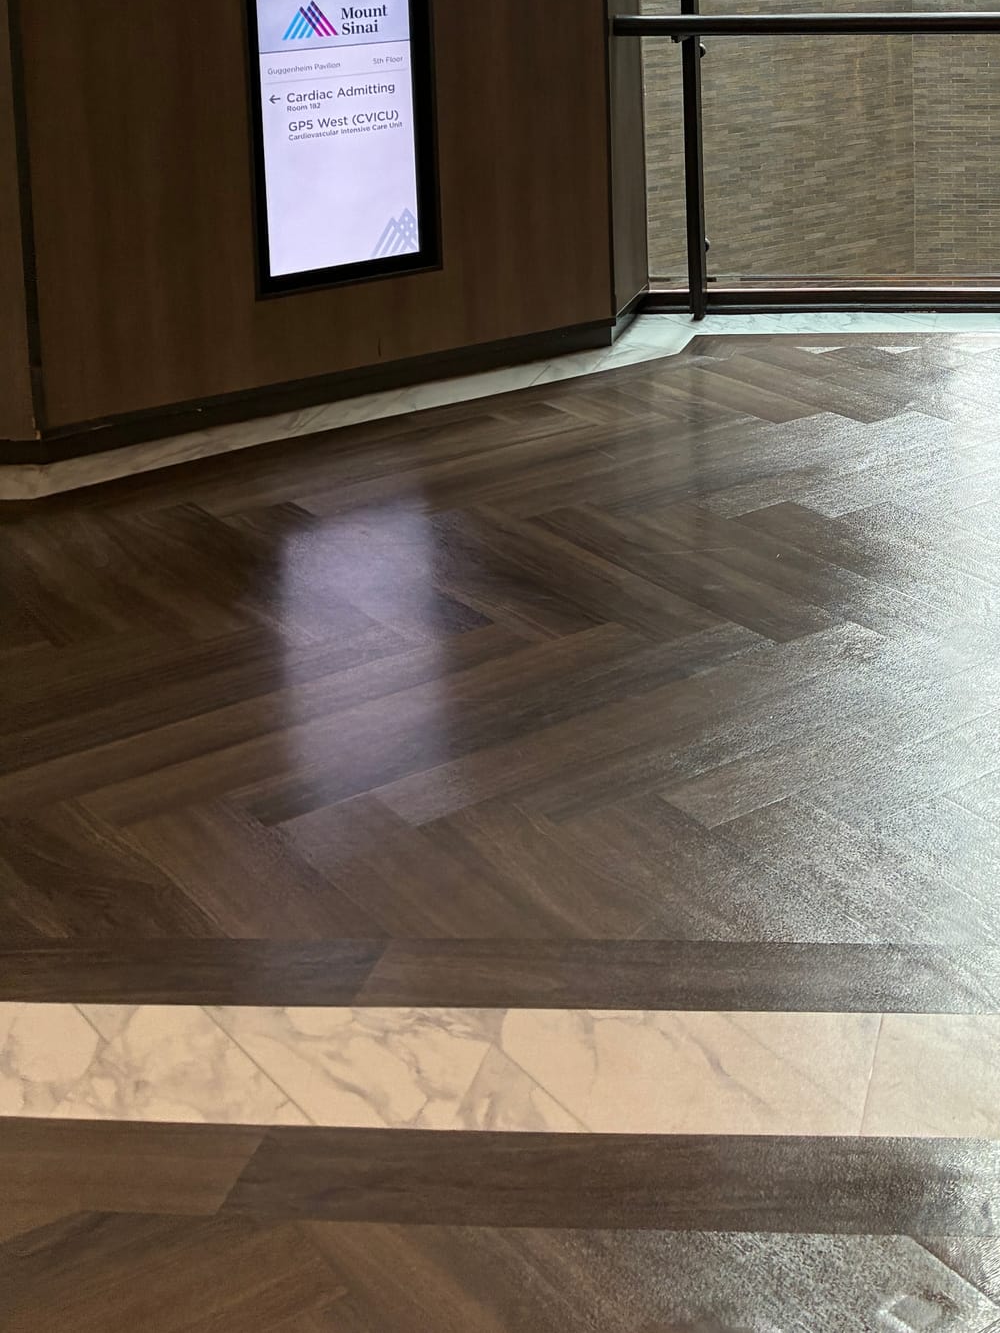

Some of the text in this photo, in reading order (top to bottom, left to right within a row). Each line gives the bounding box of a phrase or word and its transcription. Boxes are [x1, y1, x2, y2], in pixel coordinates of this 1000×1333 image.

[341, 4, 387, 20] Mount
[341, 20, 378, 36] Sinai
[286, 83, 395, 103] Cardiac Admitting
[317, 116, 348, 128] West
[352, 109, 399, 126] (CVICU)
